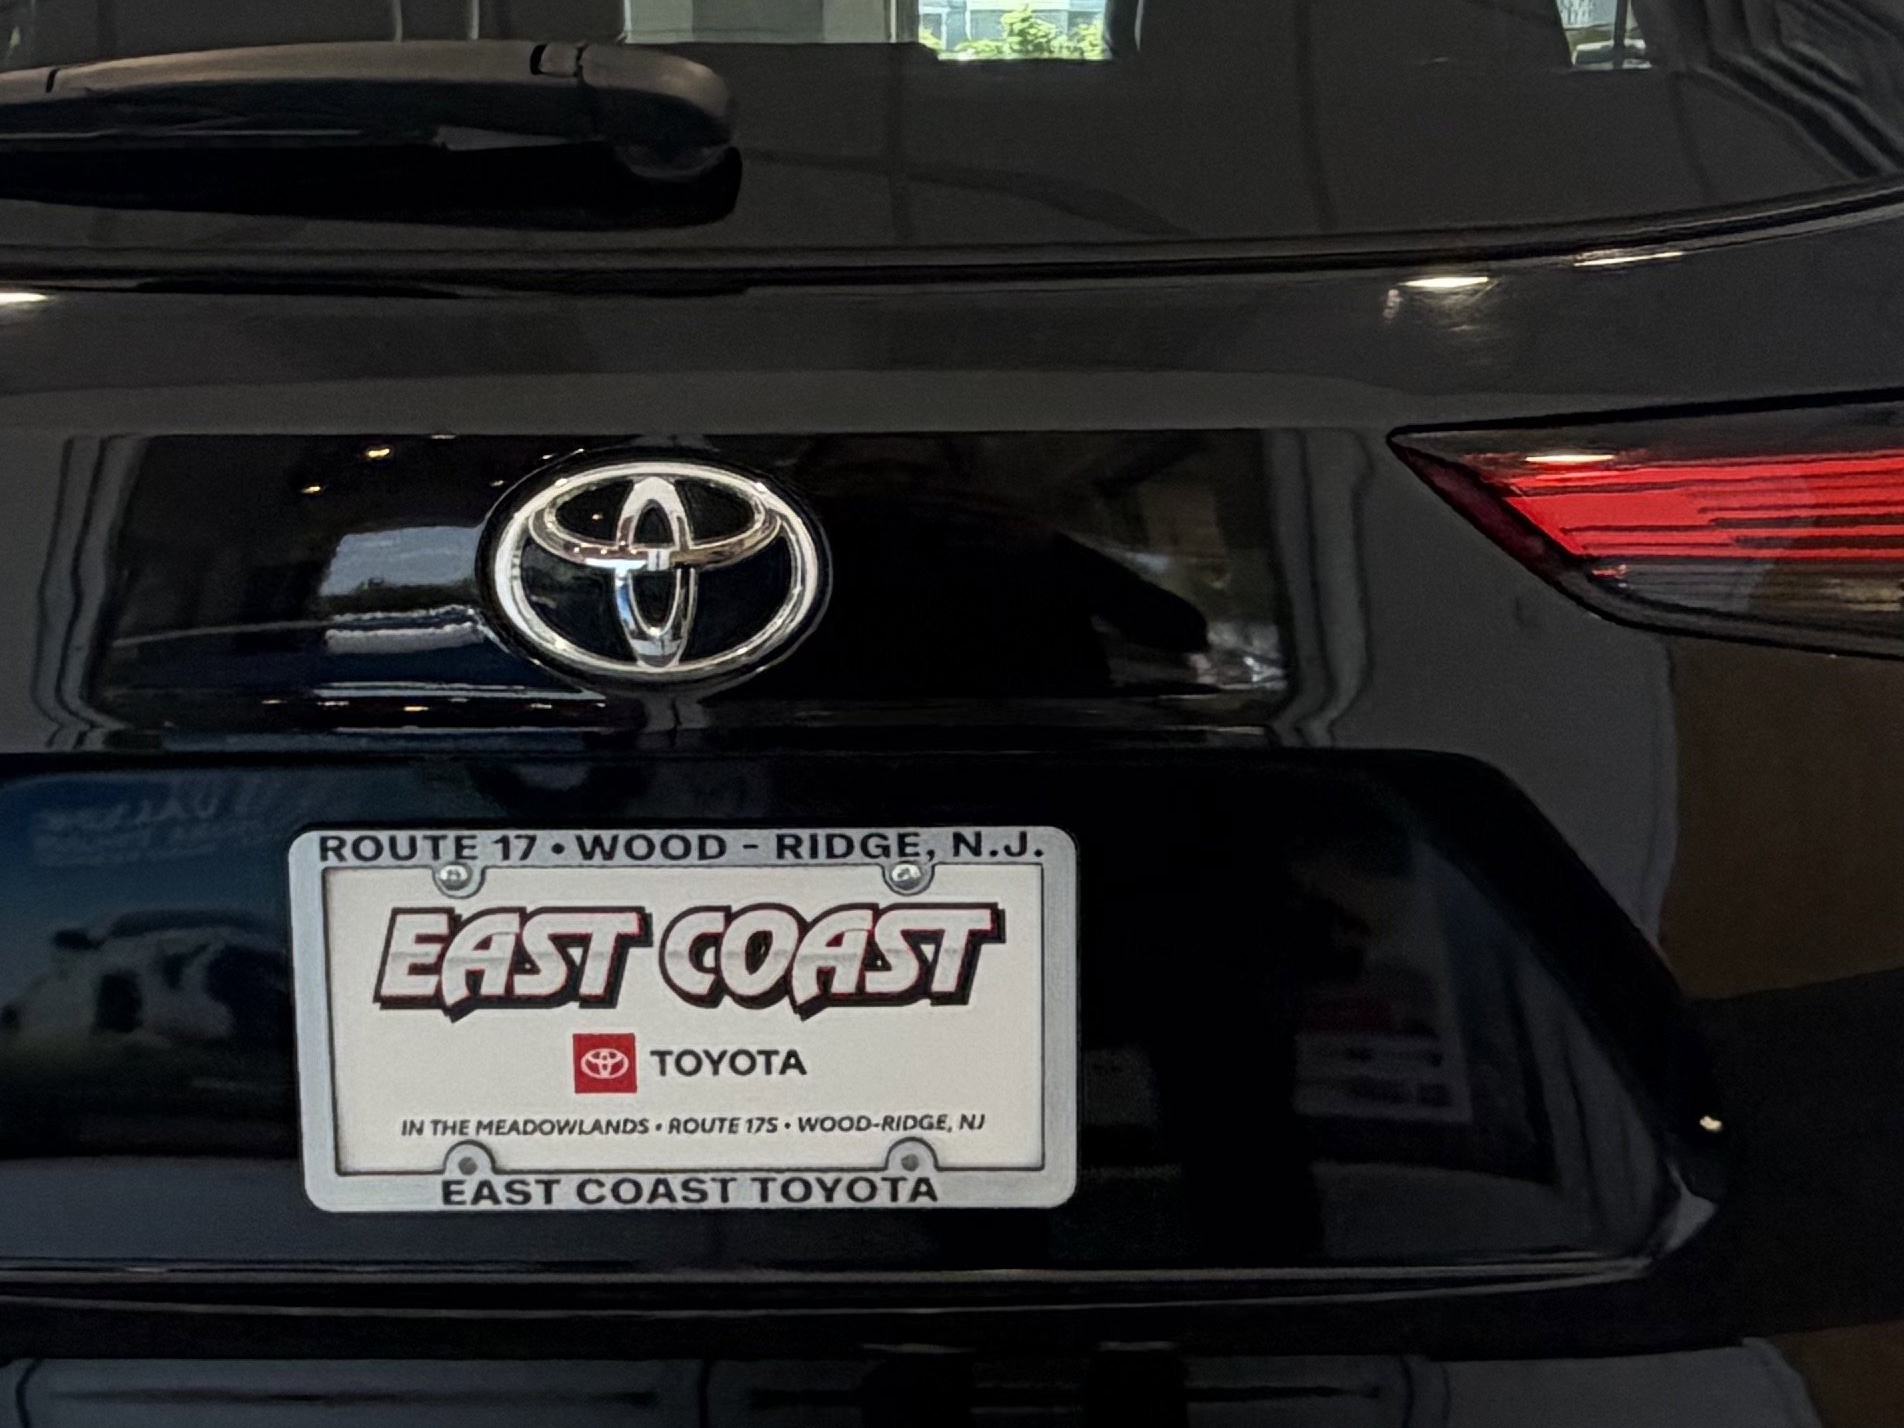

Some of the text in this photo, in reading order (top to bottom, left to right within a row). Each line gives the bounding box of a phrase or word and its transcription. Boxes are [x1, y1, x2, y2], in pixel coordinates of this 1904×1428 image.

[319, 834, 478, 862] ROUTE
[492, 834, 538, 862] 17
[573, 833, 728, 861] WOOD
[775, 832, 936, 862] RIDGE,
[952, 830, 1045, 858] N.J.
[373, 902, 1006, 1023] EAST COAST
[650, 1048, 808, 1076] TOYOTA
[400, 1118, 424, 1137] IN
[431, 1118, 470, 1137] THE
[475, 1117, 650, 1137] MEADOWLANDS
[667, 1115, 741, 1135] ROUTE
[798, 1113, 954, 1134] WOOD-RIDGE,
[959, 1113, 986, 1130] NJ
[441, 1175, 938, 1206] EAST COAST TOYOTA
